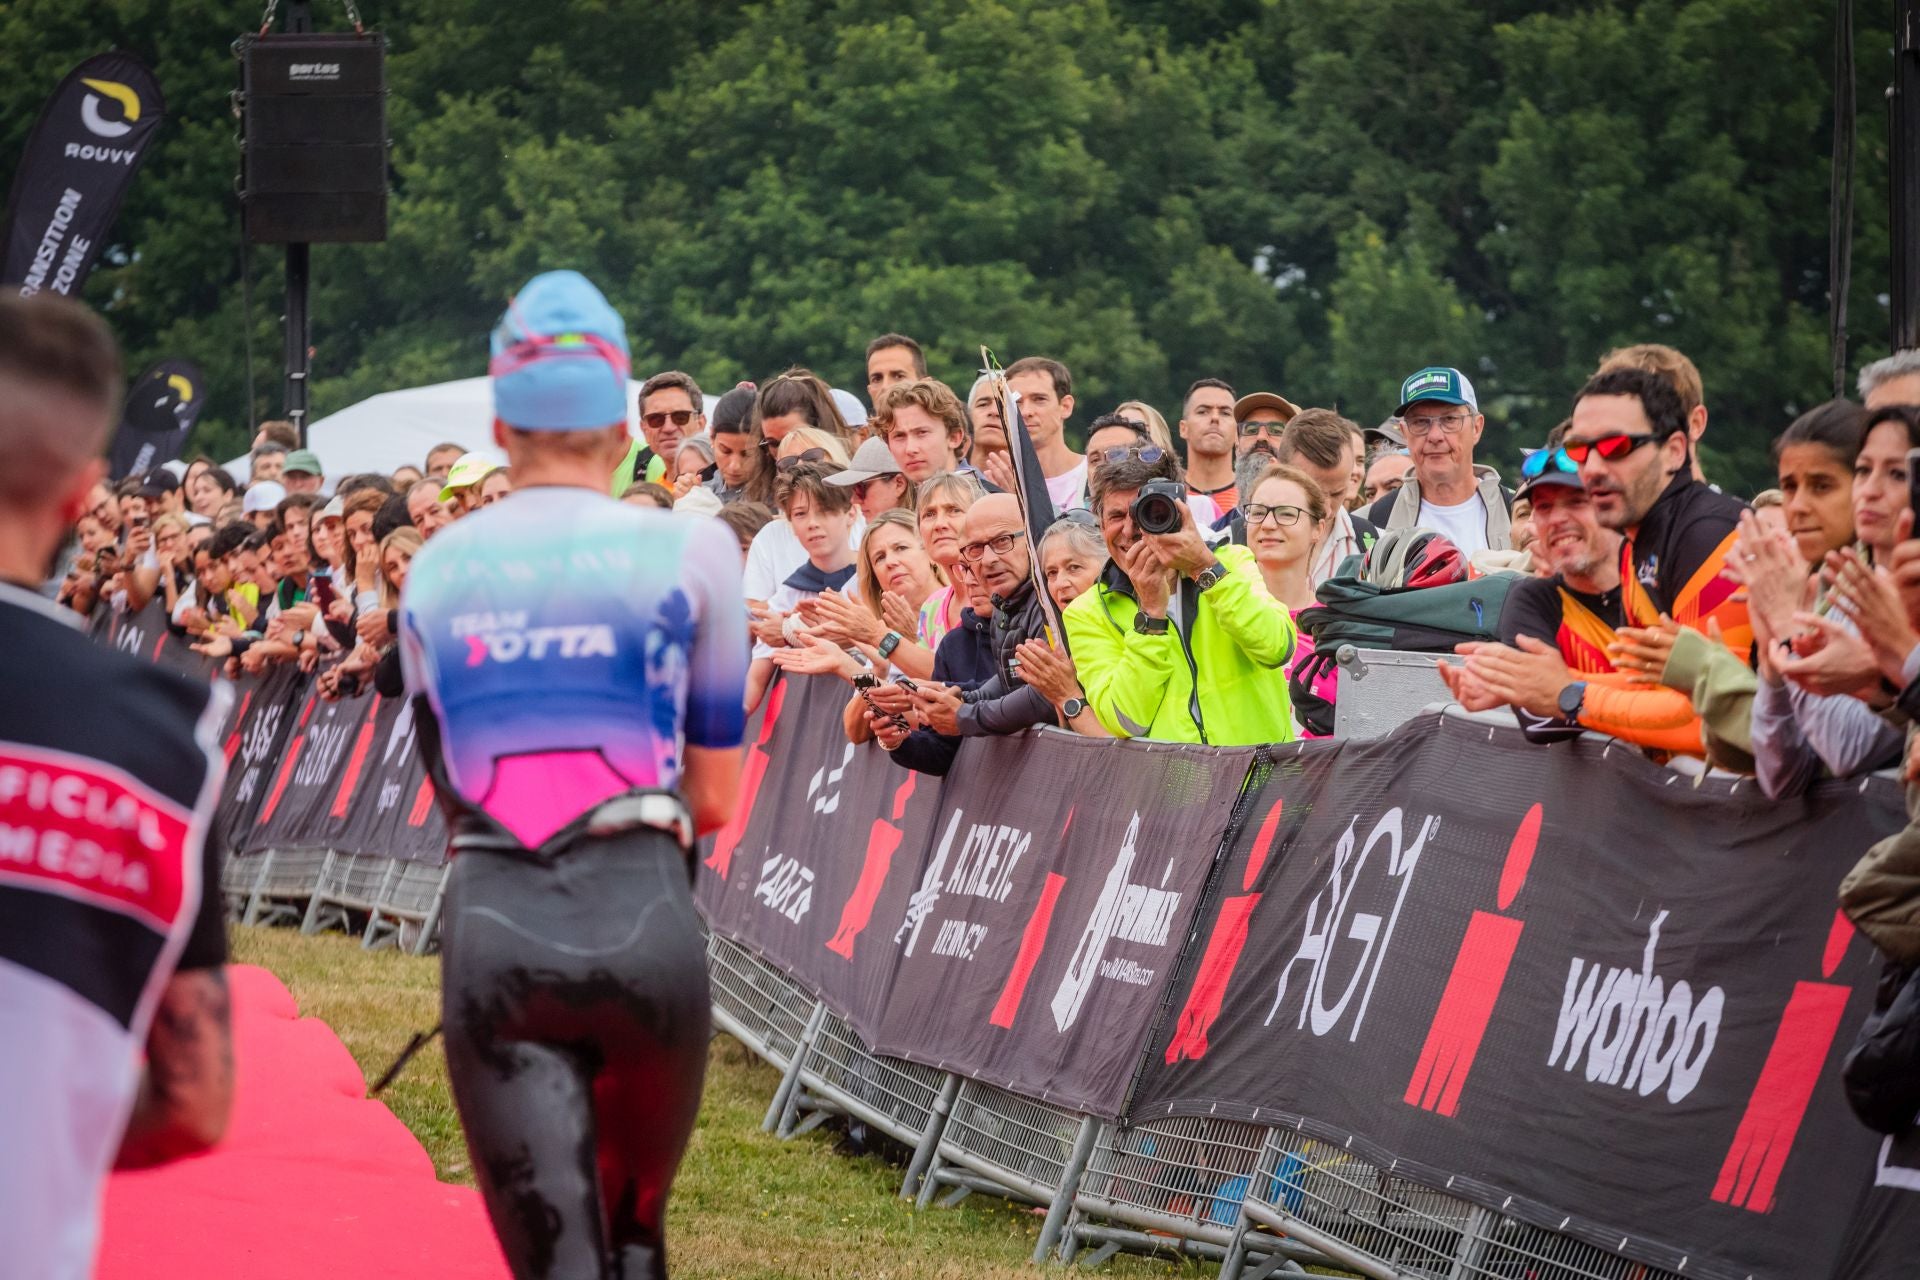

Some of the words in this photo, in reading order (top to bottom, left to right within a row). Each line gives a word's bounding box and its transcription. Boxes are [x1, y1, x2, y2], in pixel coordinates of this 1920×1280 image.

[64, 142, 136, 166] ROUVY
[20, 187, 82, 297] RANSITION
[50, 234, 91, 296] ZONE
[451, 610, 527, 637] TEAM
[1548, 909, 1725, 1103] wahoo
